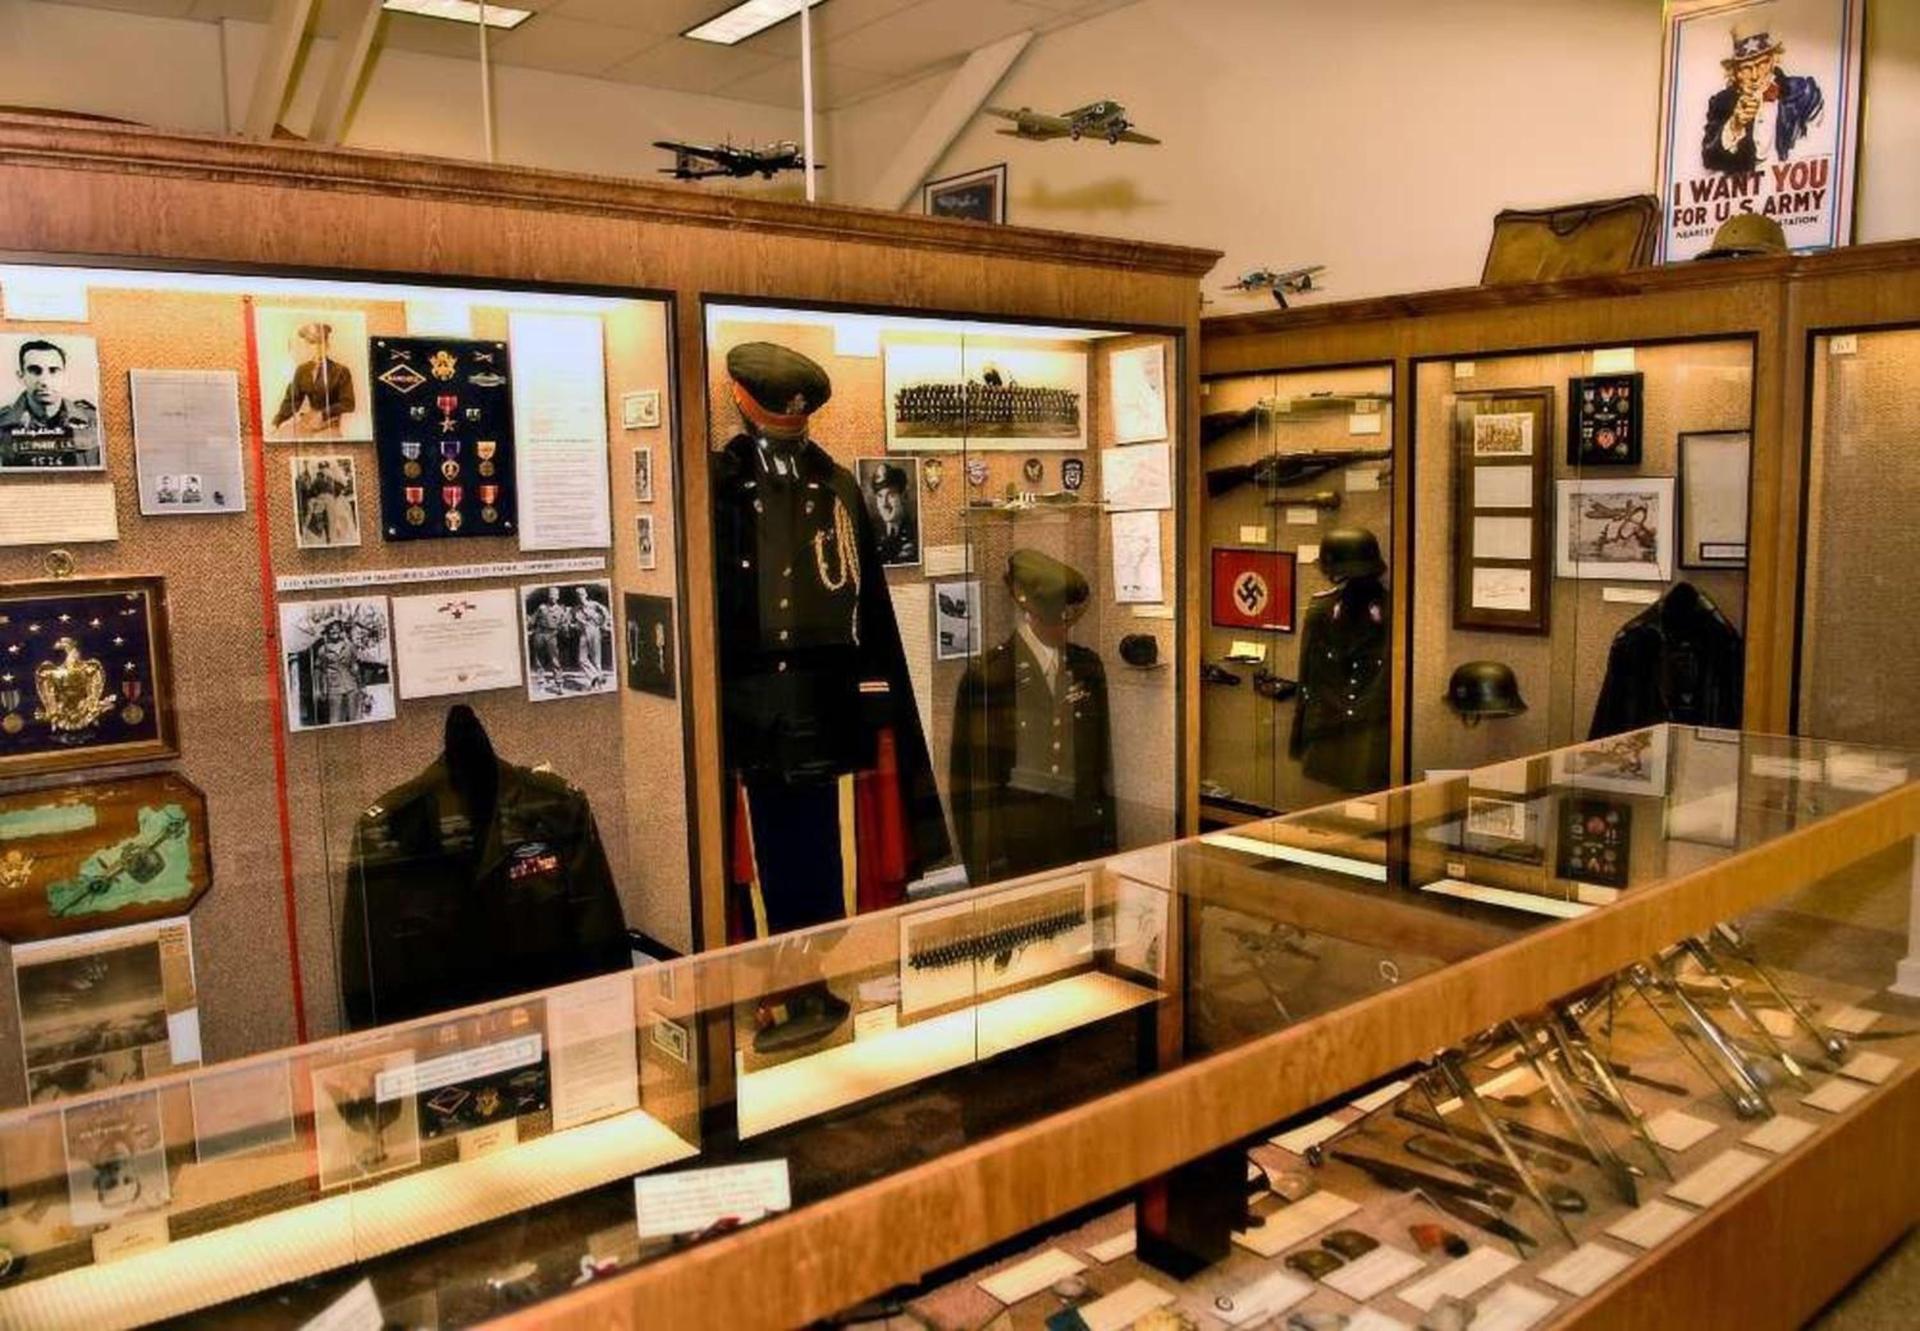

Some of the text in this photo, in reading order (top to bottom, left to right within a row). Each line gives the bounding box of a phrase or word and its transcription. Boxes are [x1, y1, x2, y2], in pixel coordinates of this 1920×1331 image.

[1674, 159, 1829, 206] I WANT YOU
[1673, 207, 1708, 228] FOR
[1762, 189, 1826, 216] ARMY
